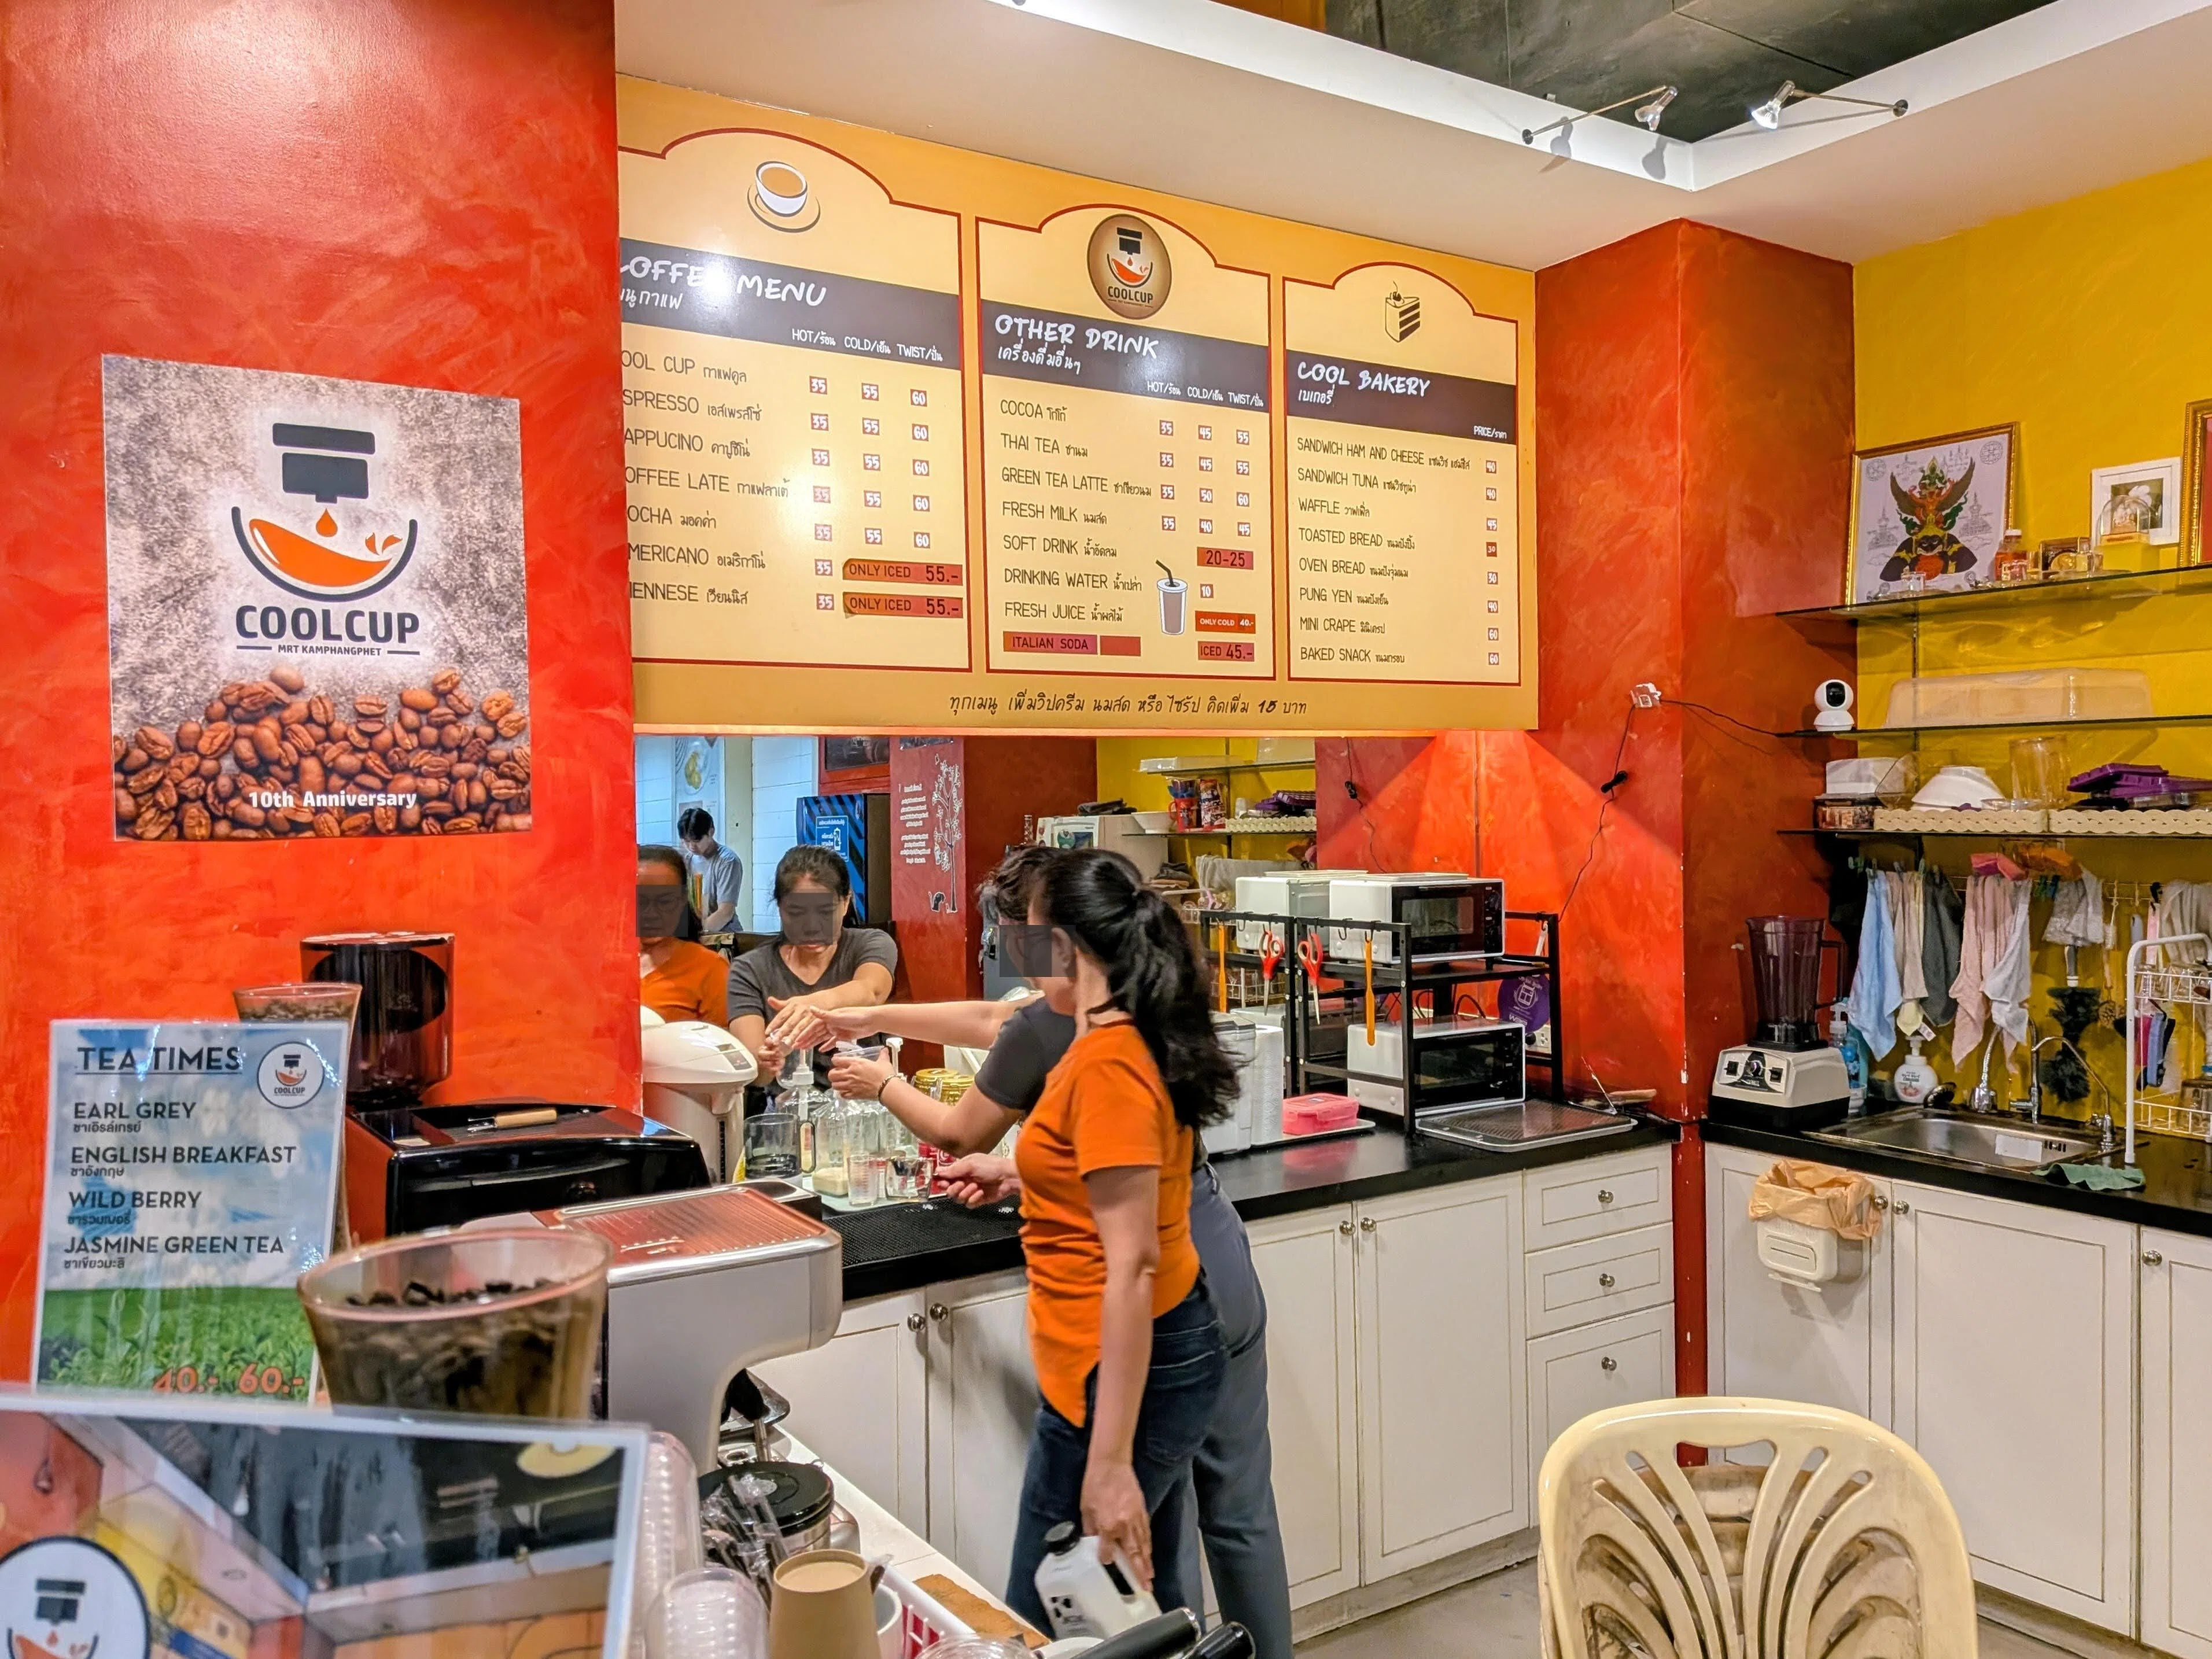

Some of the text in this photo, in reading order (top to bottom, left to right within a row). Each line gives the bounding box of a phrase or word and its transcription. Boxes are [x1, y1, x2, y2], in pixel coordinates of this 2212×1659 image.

[620, 256, 827, 307] OFFE MENU
[1108, 286, 1153, 304] COOLCUP
[995, 315, 1159, 359] OTHER DRINK
[621, 350, 655, 371] OOL
[663, 356, 695, 375] CUP
[811, 378, 827, 393] 35
[862, 384, 878, 399] 55
[912, 390, 926, 405] 60
[1297, 362, 1431, 397] COOL BAKERY
[622, 389, 699, 414] SPRESSO
[812, 414, 828, 430] 35
[864, 419, 879, 434] 55
[913, 426, 928, 440] 60
[1000, 399, 1043, 419] COCOA
[1160, 422, 1173, 435] 35
[1199, 427, 1212, 440] 45
[1237, 431, 1249, 444] 55
[624, 427, 703, 452] APPUCINO
[813, 449, 828, 466] 35
[864, 455, 880, 471] 55
[914, 460, 928, 475] 60
[1001, 433, 1028, 451] THAI
[1034, 437, 1060, 454] TEA
[1160, 454, 1173, 467] 35
[1200, 459, 1212, 471] 45
[1237, 462, 1249, 475] 55
[1297, 437, 1496, 473] SANDWICH HAM AND CHEESE 40
[625, 466, 680, 488] OFFEE
[688, 473, 729, 492] LATE
[865, 492, 881, 507] 55
[915, 497, 929, 511] 60
[1002, 467, 1249, 506] GREEN TEA LATTE 35 50 60
[1297, 467, 1496, 500] SANDWICH TUNA 40
[627, 505, 672, 525] OCHA
[867, 529, 882, 544] 55
[916, 533, 930, 547] 60
[1002, 501, 1044, 519] FRESH
[1050, 505, 1078, 522] MILK
[1163, 517, 1175, 530] 35
[1200, 520, 1212, 533] 40
[1238, 523, 1251, 536] 45
[1298, 497, 1497, 530] WAFFLE 45
[1003, 534, 1037, 551] SOFT
[1043, 537, 1078, 555] DRINK
[1206, 550, 1245, 567] 20-25
[1299, 527, 1345, 544] TOASTED
[1350, 532, 1383, 547] BREAD
[628, 542, 709, 565] MERICANO
[816, 560, 832, 575] 35
[849, 563, 880, 576] ONLY
[884, 565, 910, 578] ICED
[926, 565, 958, 582] 55.-
[1299, 557, 1327, 573] OVEN
[1332, 560, 1365, 574] BREAD
[629, 581, 699, 602] IENNESE
[817, 594, 833, 609] 35
[850, 597, 880, 610] ONLY
[884, 599, 911, 611] ICED
[926, 598, 958, 615] 55.-
[1005, 568, 1059, 586] DRINKING
[1066, 572, 1108, 589] WATER
[1201, 585, 1211, 598] 10
[1300, 587, 1327, 602] PUNG
[1332, 589, 1352, 603] YEN
[235, 604, 420, 644] COOLCUP
[1005, 602, 1046, 618] FRESH
[1052, 604, 1086, 621] JUICE
[1300, 617, 1498, 640] MINI CRAPE 60
[278, 644, 382, 656] MRT KAMPHANGPHET
[1012, 636, 1253, 660] ITALIAN SODA ICED 45.-
[1300, 647, 1499, 664] BAKED SNACK 60
[949, 695, 998, 716] ทุกเมนู
[1093, 695, 1130, 712] นมสด
[1138, 694, 1163, 713] หรือ
[1283, 702, 1307, 714] บาท
[249, 790, 417, 809] 10th Anniversary
[77, 1046, 242, 1071] TEA TIMES
[74, 1102, 196, 1119] EARL GREY
[72, 1146, 296, 1164] ENGLISH BREAKFAST
[69, 1191, 202, 1208] WILD BERRY
[64, 1236, 284, 1254] JASMINE GREEN TEA
